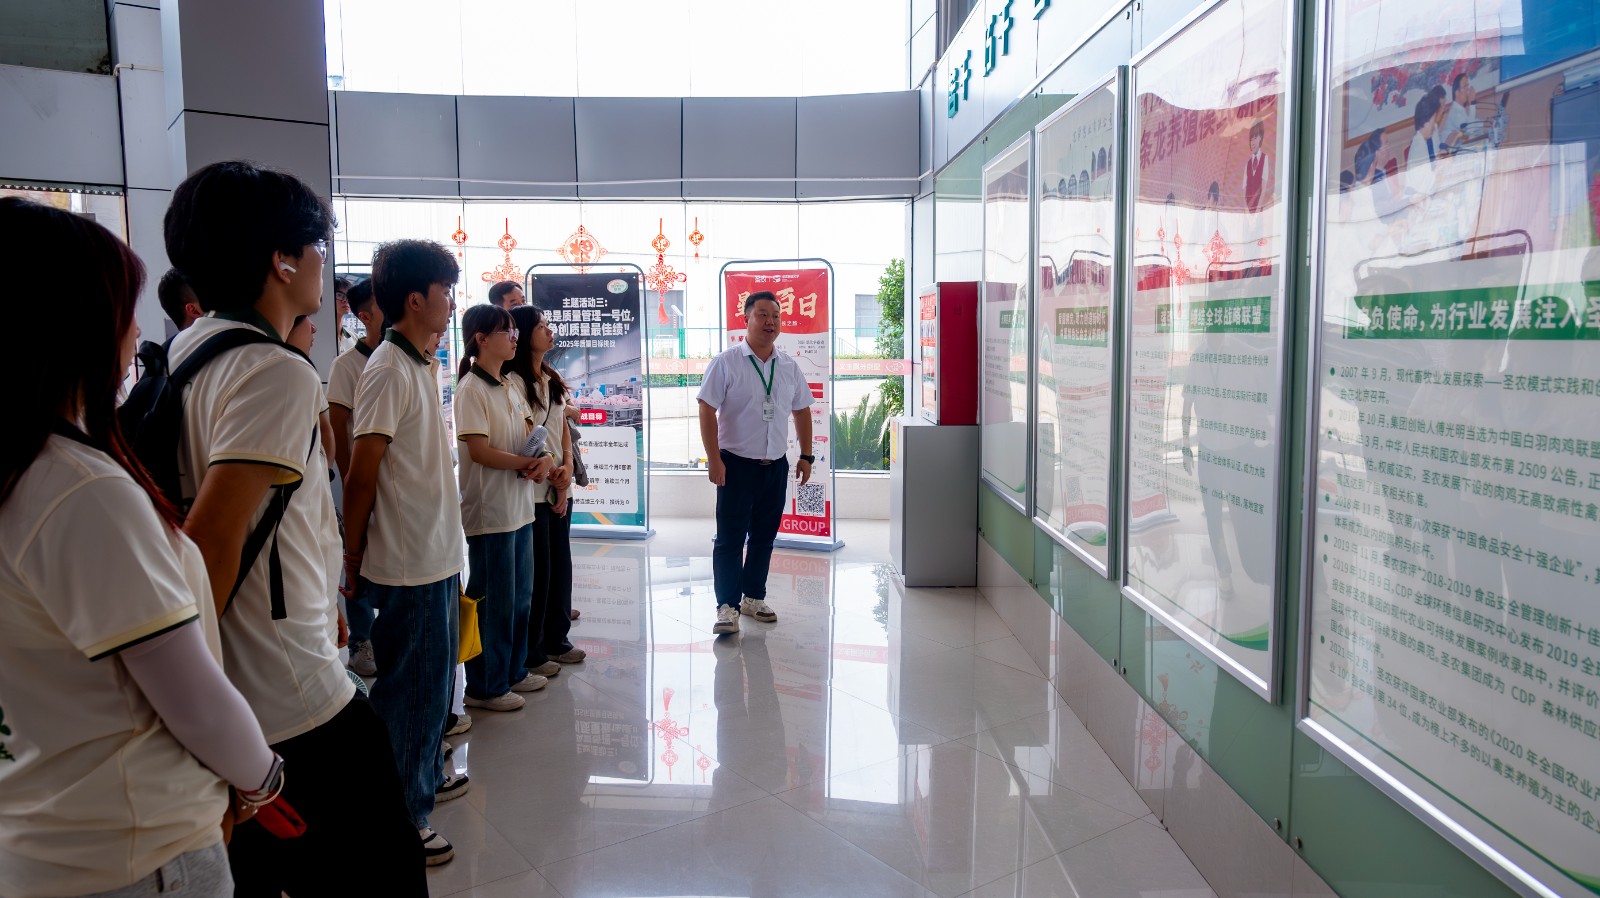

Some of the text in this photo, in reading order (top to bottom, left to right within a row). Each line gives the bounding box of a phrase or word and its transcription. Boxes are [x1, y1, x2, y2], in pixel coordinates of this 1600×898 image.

[735, 287, 818, 318] 星百日
[782, 518, 826, 533] GROUP
